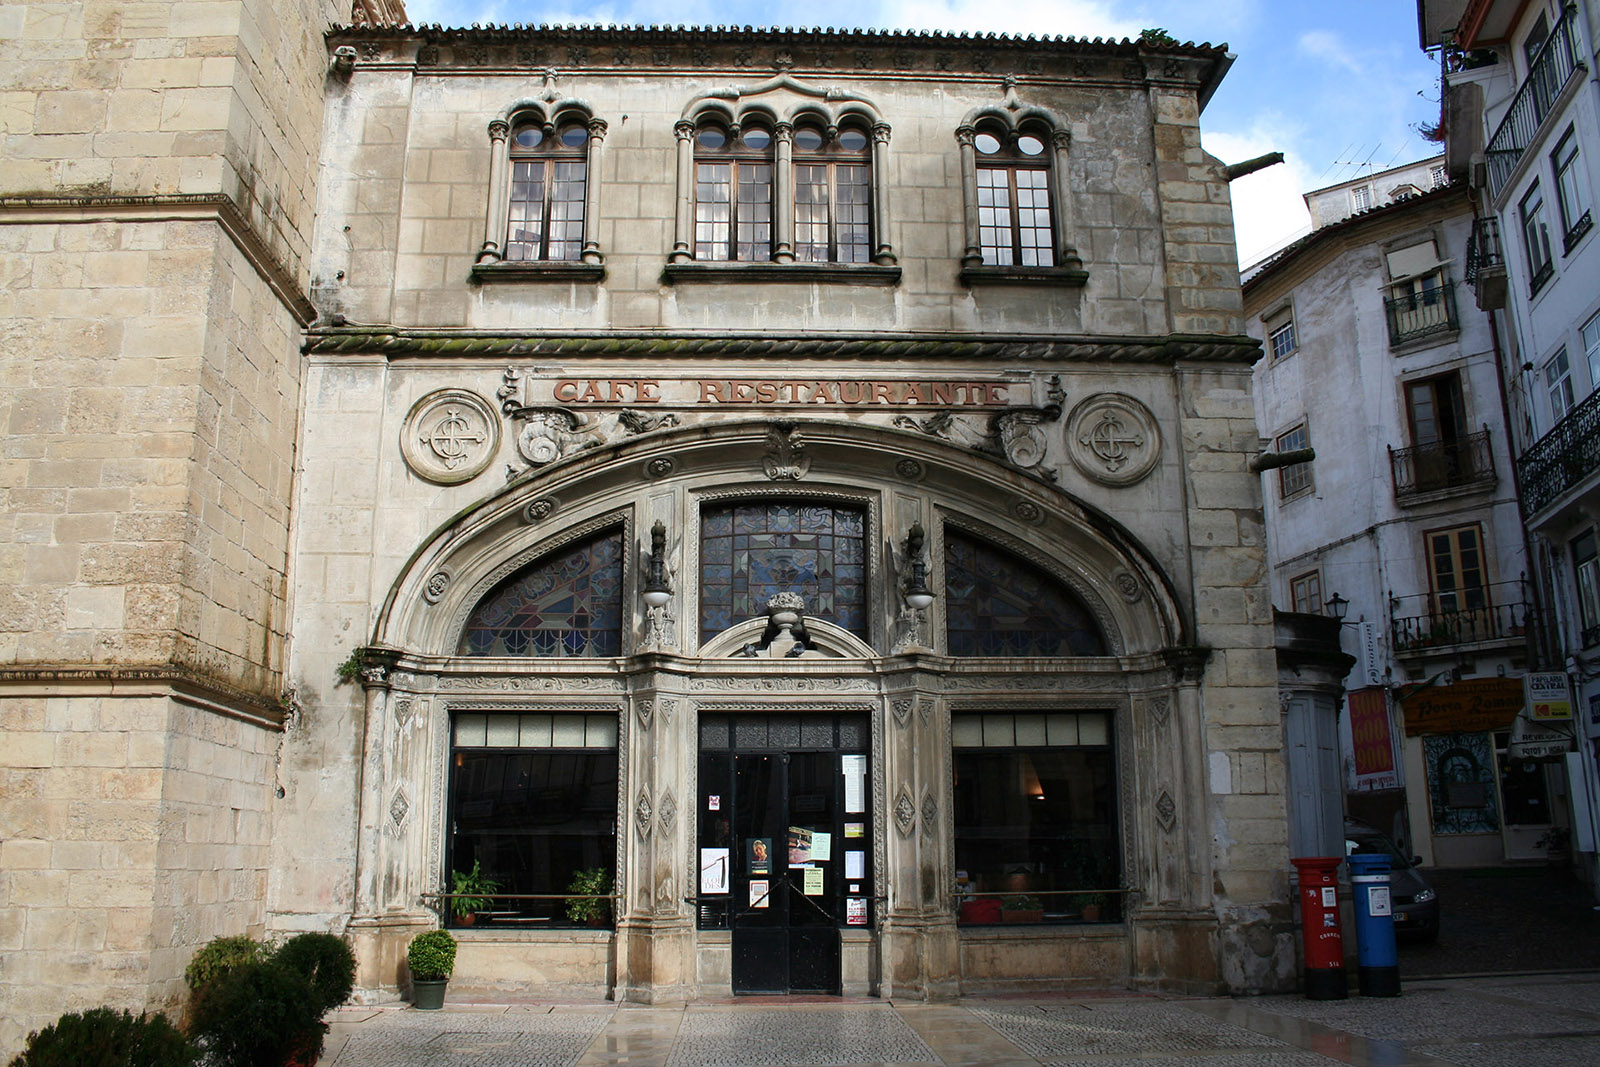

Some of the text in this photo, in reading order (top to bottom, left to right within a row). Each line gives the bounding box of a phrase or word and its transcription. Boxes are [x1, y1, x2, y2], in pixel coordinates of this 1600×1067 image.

[553, 379, 1009, 405] CAFE RESTAURANTE
[1531, 682, 1566, 690] CENTRAL
[1522, 747, 1541, 755] FOTOS
